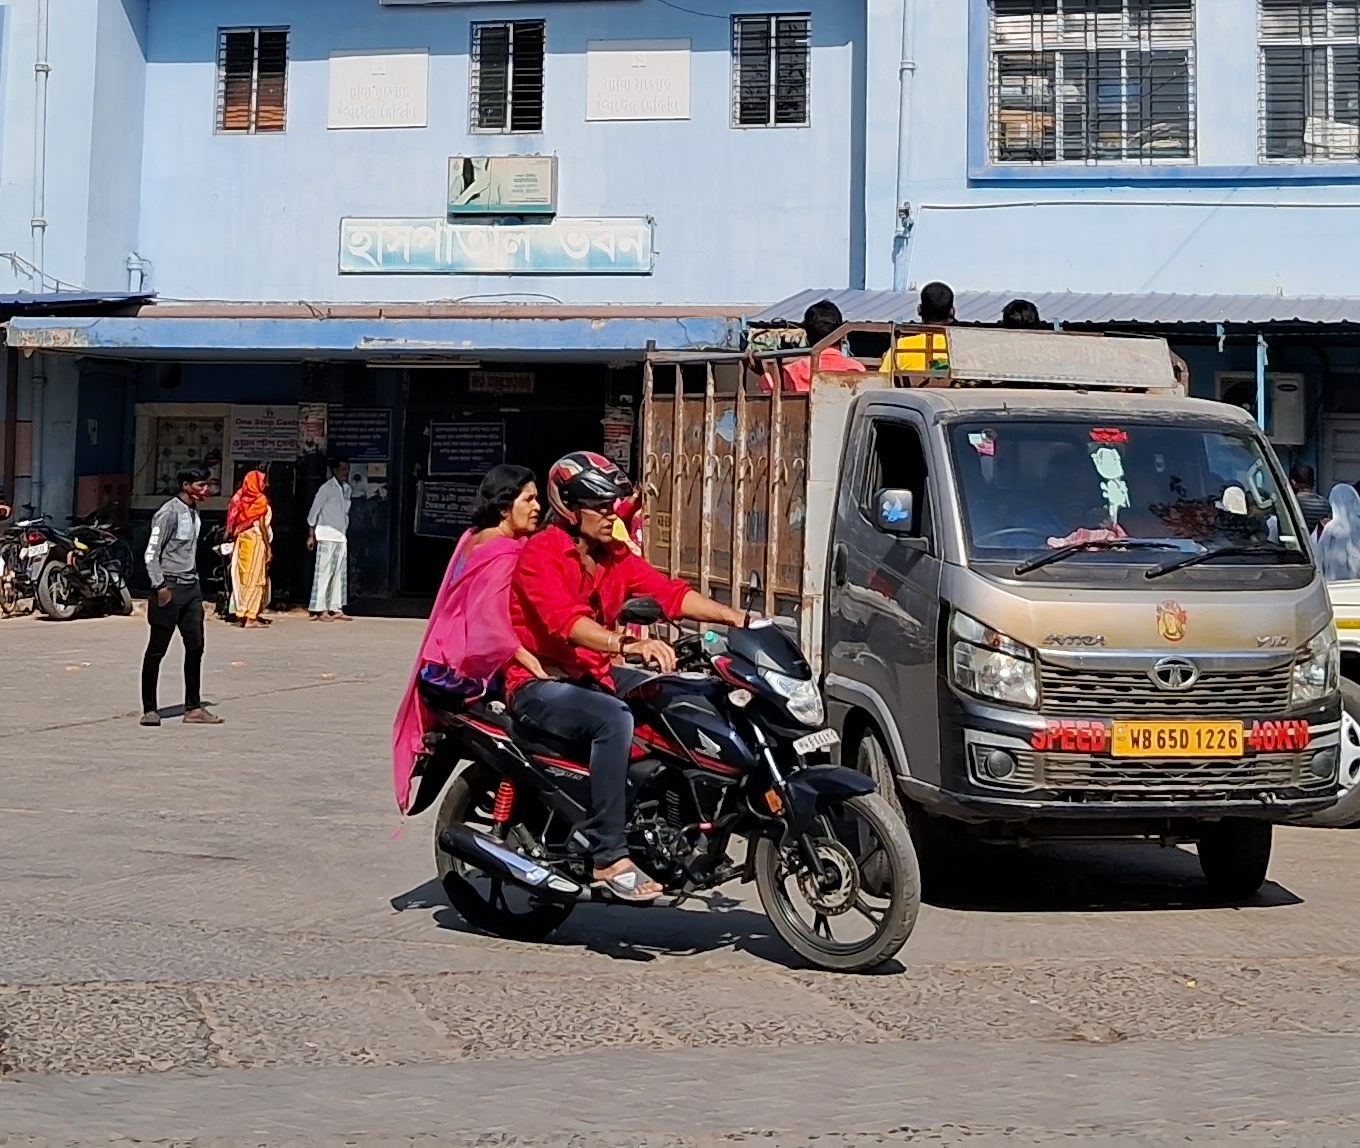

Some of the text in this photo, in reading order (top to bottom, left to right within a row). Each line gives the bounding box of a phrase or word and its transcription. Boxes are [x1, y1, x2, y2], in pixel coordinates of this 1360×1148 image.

[344, 222, 645, 266] হাসপাতাল ভবন
[254, 418, 274, 426] Stop
[1031, 720, 1106, 751] SPEED
[1130, 728, 1151, 750] WB
[1196, 728, 1238, 749] 1226
[1248, 720, 1309, 751] 40KM
